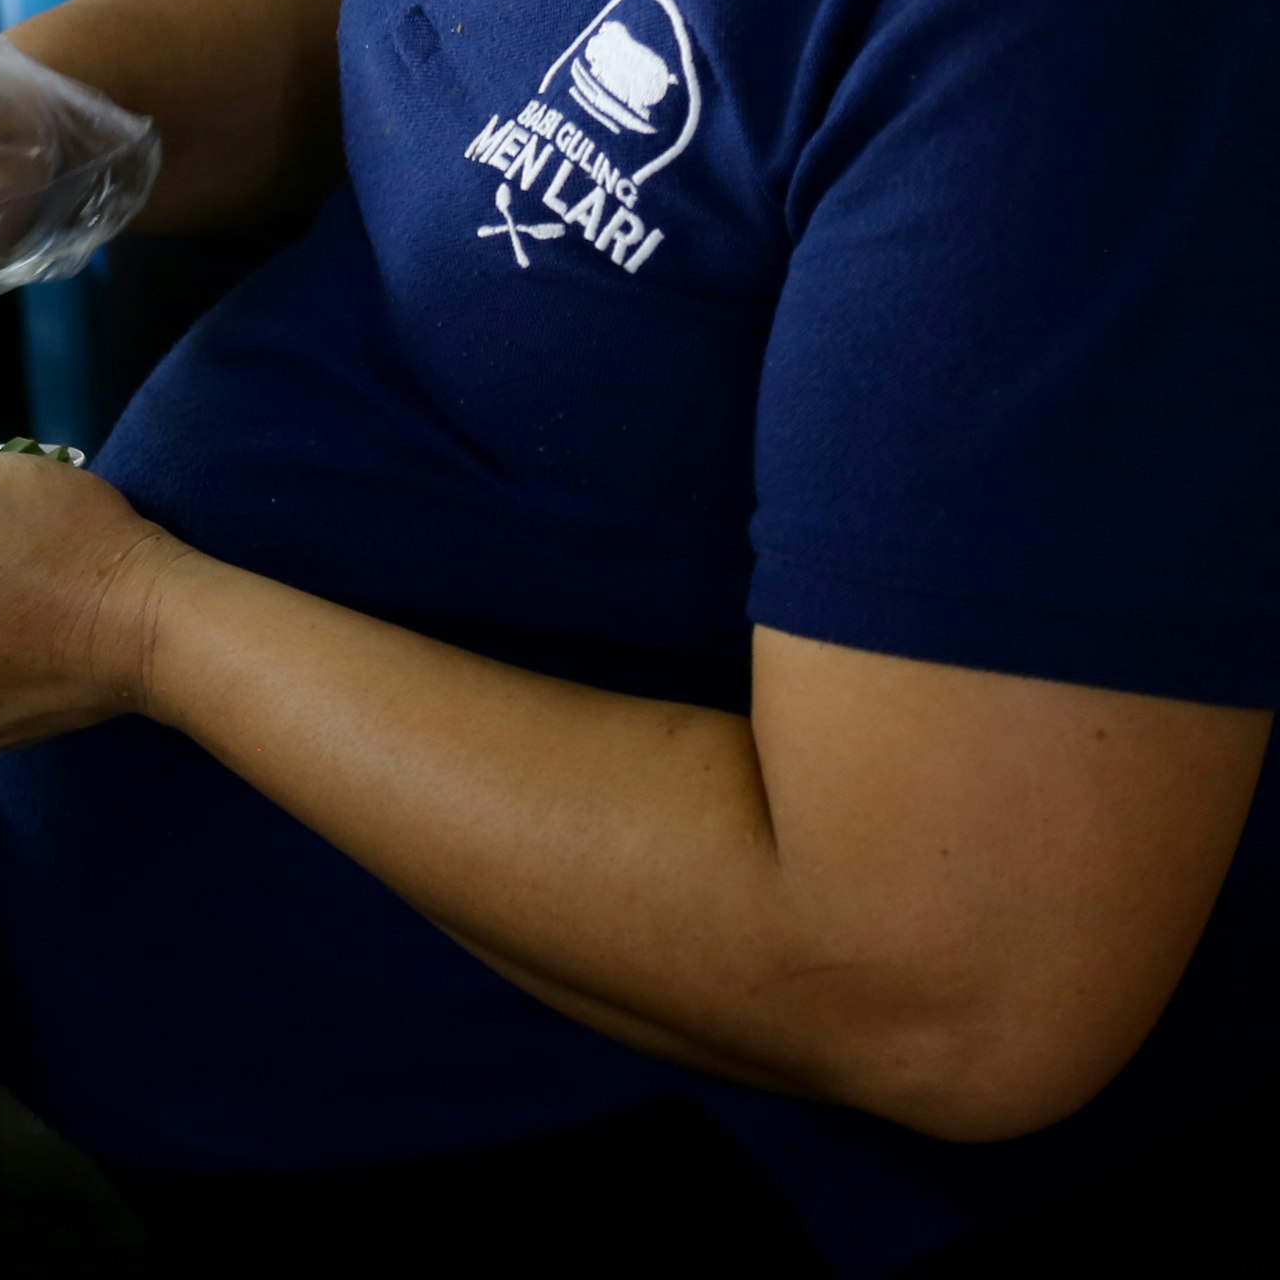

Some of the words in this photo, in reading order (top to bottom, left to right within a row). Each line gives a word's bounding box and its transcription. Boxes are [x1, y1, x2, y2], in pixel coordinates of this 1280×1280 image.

[464, 114, 554, 191] MEN
[542, 159, 664, 274] LARI
[517, 99, 563, 140] BABI
[555, 122, 638, 208] GULING
